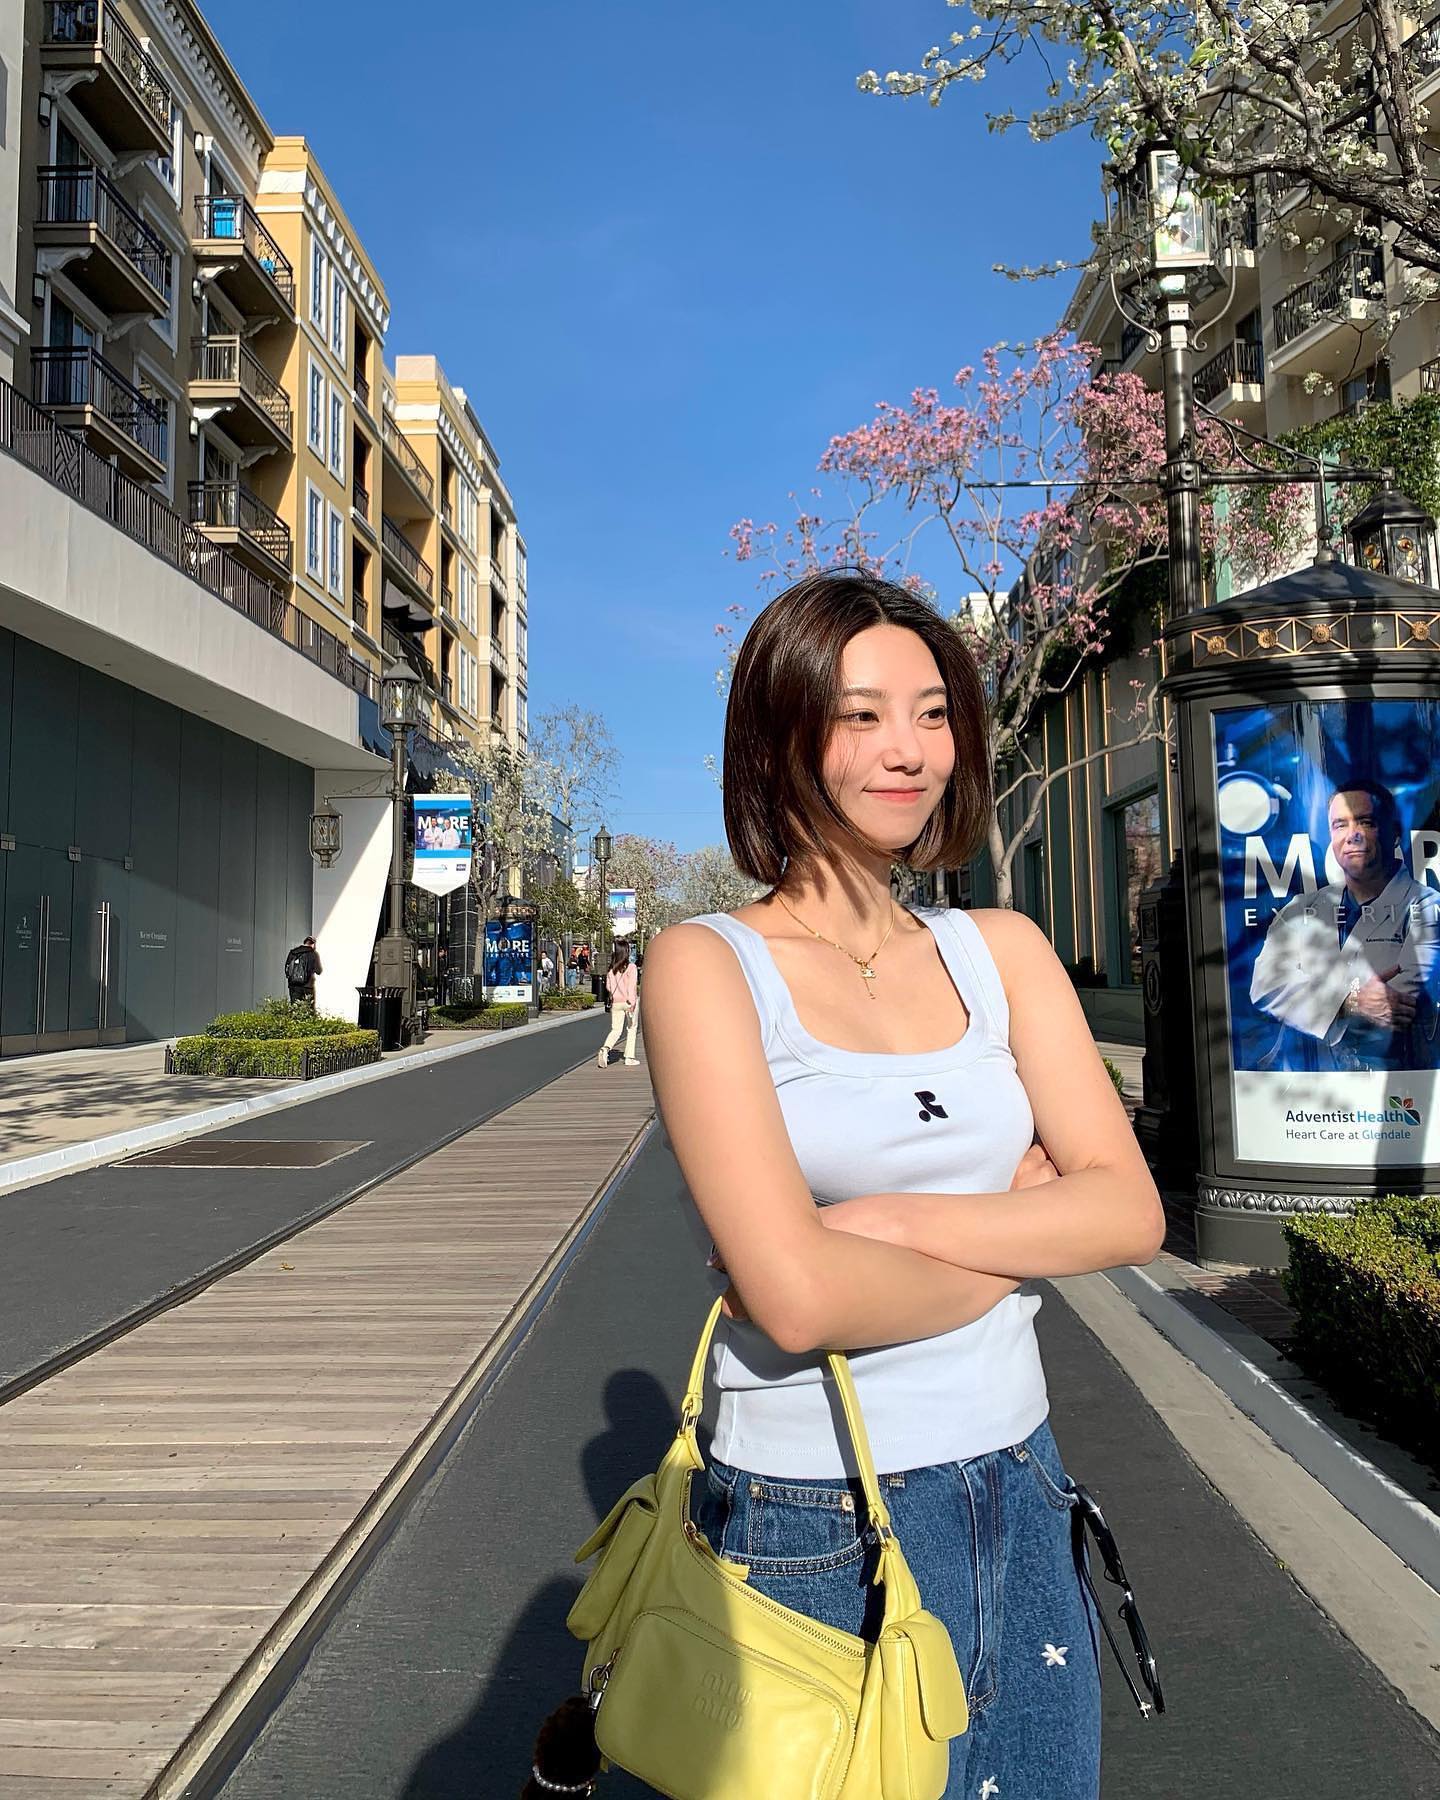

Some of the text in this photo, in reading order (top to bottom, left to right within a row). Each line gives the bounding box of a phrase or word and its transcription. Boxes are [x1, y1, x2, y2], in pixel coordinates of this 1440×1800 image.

[417, 815, 469, 830] MRE
[1243, 829, 1440, 899] MR
[1286, 1129, 1412, 1140] Heart Care at Glendale
